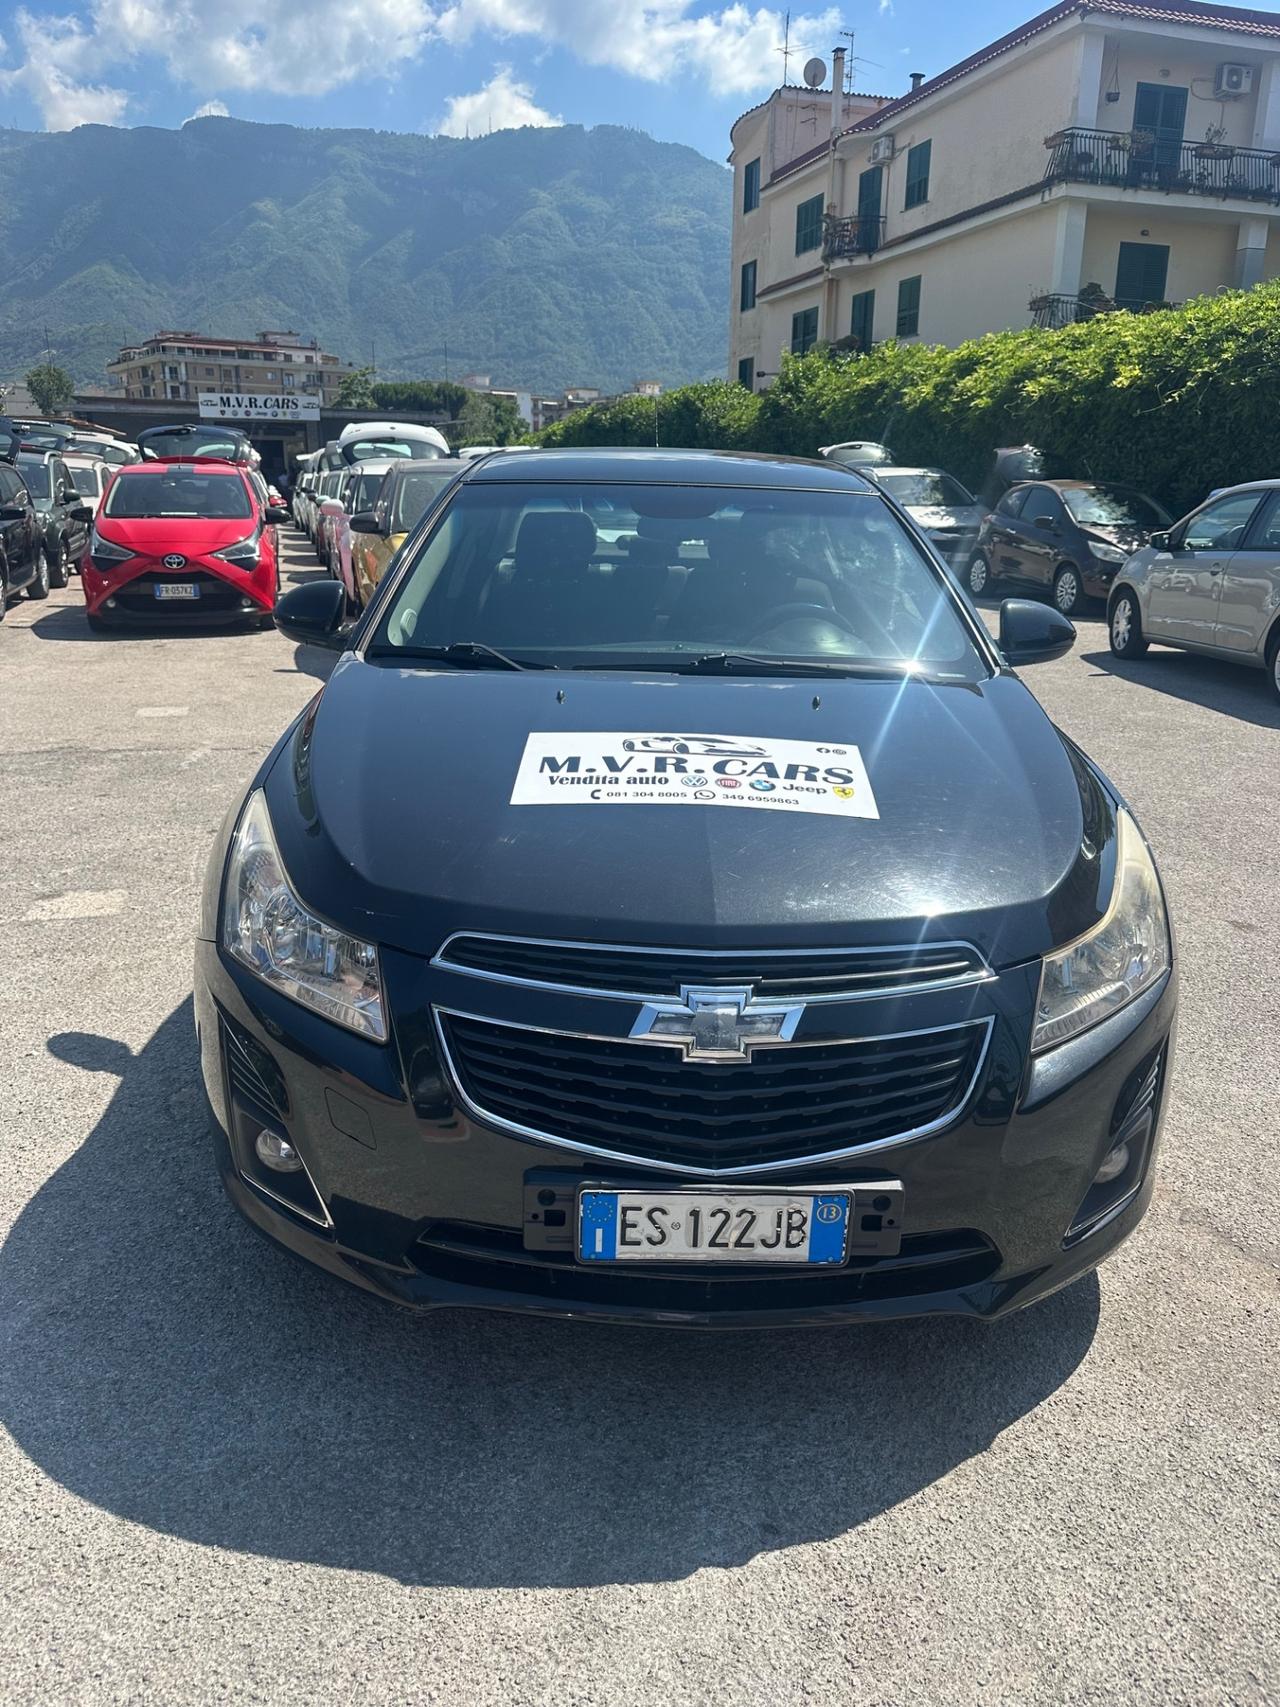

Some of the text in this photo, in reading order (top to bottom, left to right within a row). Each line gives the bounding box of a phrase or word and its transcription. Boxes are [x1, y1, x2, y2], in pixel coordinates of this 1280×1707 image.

[548, 774, 669, 785] Vendita auto
[782, 784, 827, 795] Jeep
[606, 790, 627, 798] 081
[632, 790, 654, 798] 304
[722, 793, 744, 801] 349
[822, 1206, 837, 1219] 13
